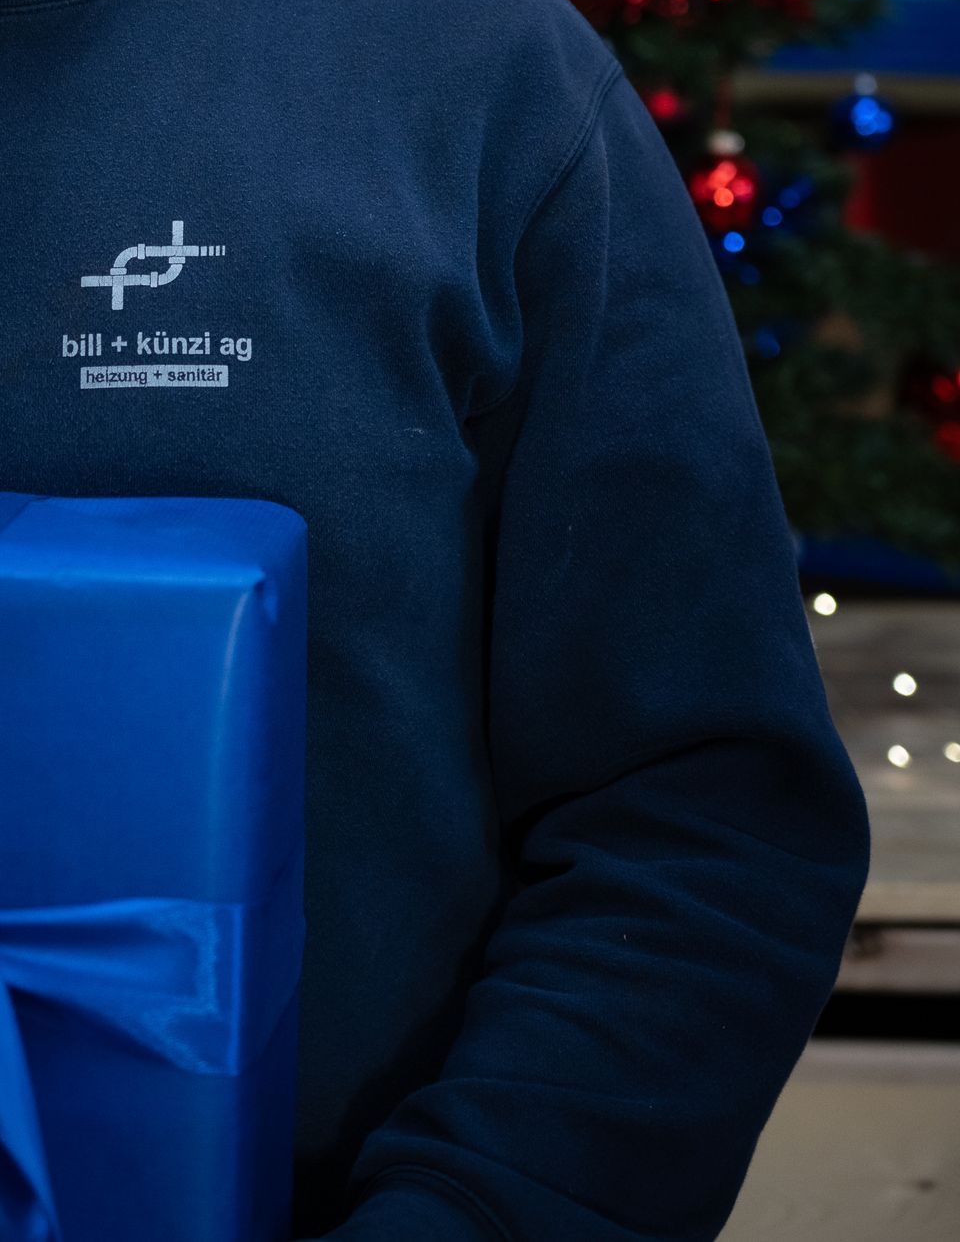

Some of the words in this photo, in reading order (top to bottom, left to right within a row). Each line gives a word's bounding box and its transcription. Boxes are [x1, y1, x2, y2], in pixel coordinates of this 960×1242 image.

[62, 333, 102, 358] bill
[111, 335, 128, 353] +
[136, 331, 211, 356] künzi
[219, 336, 253, 362] ag
[85, 369, 148, 385] heizung
[153, 370, 163, 380] +
[167, 367, 223, 383] sanitär
